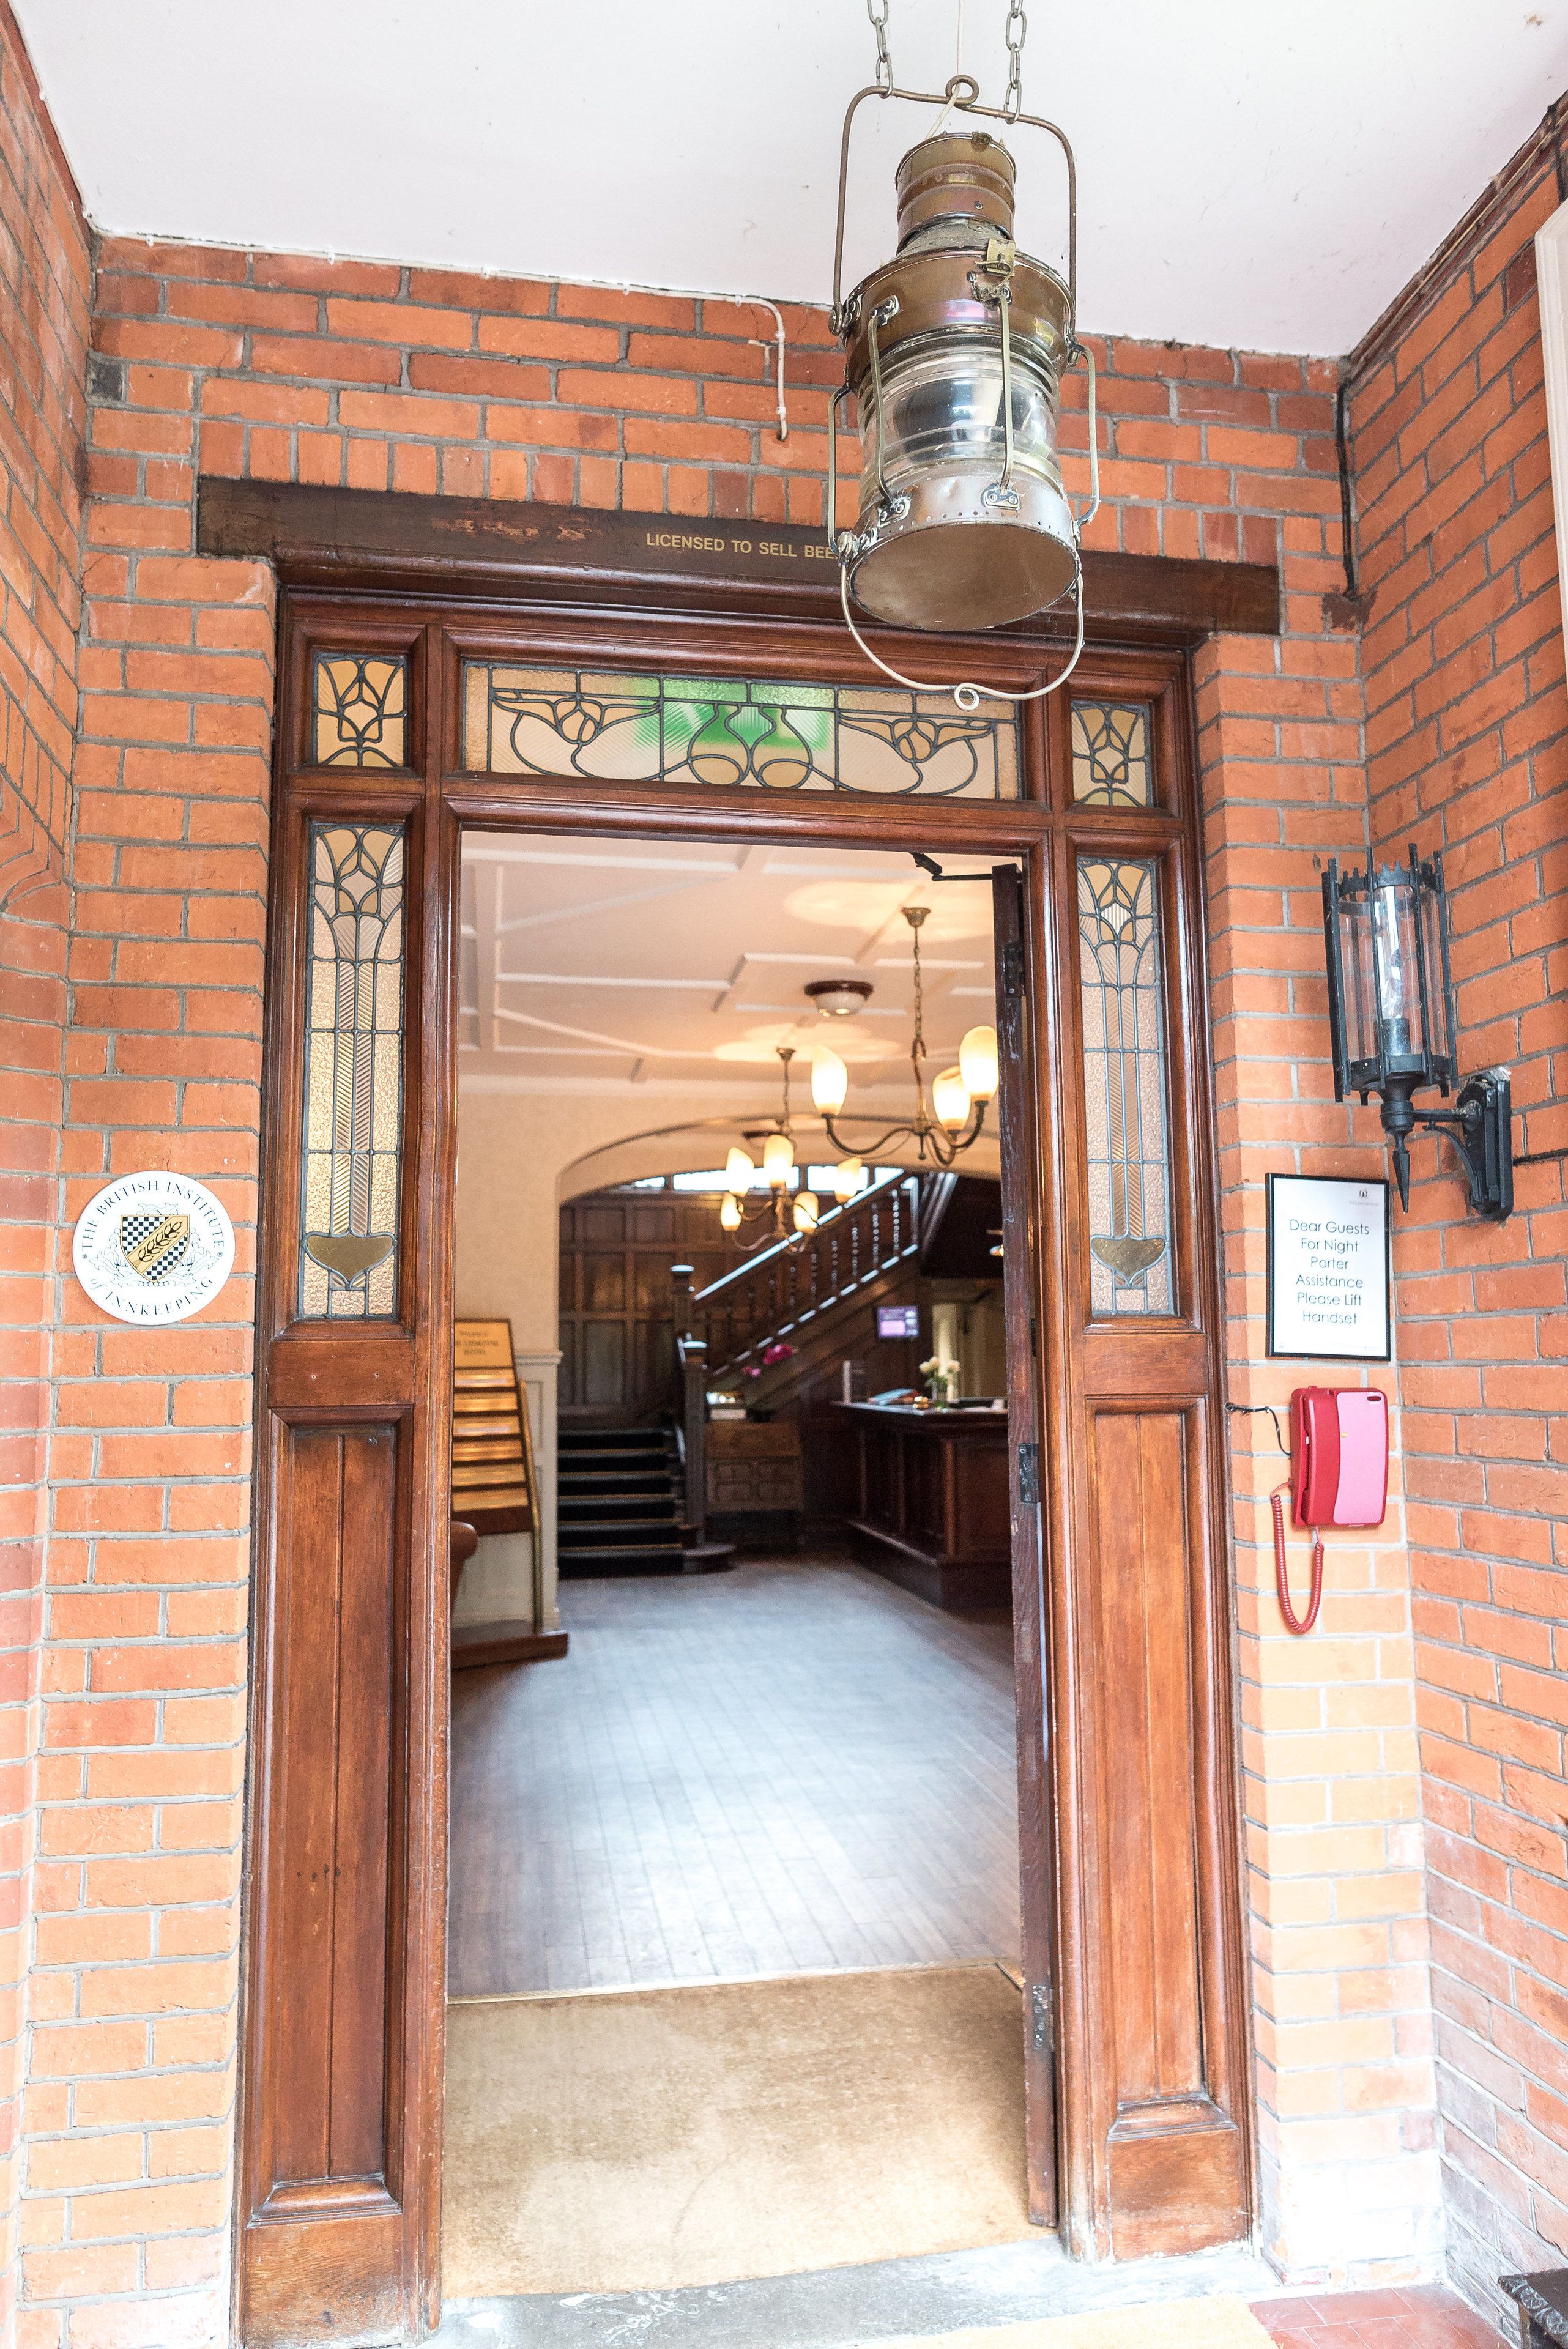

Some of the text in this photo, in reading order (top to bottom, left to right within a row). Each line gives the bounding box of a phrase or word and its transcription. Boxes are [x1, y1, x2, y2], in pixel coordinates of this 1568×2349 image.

[646, 533, 839, 560] LICENSED TO SELL BEE
[81, 1181, 225, 1251] THE BRITISH INSTITUTE
[1290, 1219, 1370, 1235] Dear Guests
[1301, 1238, 1359, 1254] For Night
[1310, 1256, 1349, 1269] Porter
[1296, 1274, 1364, 1288] Assistance
[105, 1277, 213, 1315] INNKEEPING
[1298, 1292, 1361, 1306] Please Lift
[1302, 1310, 1358, 1324] Handset
